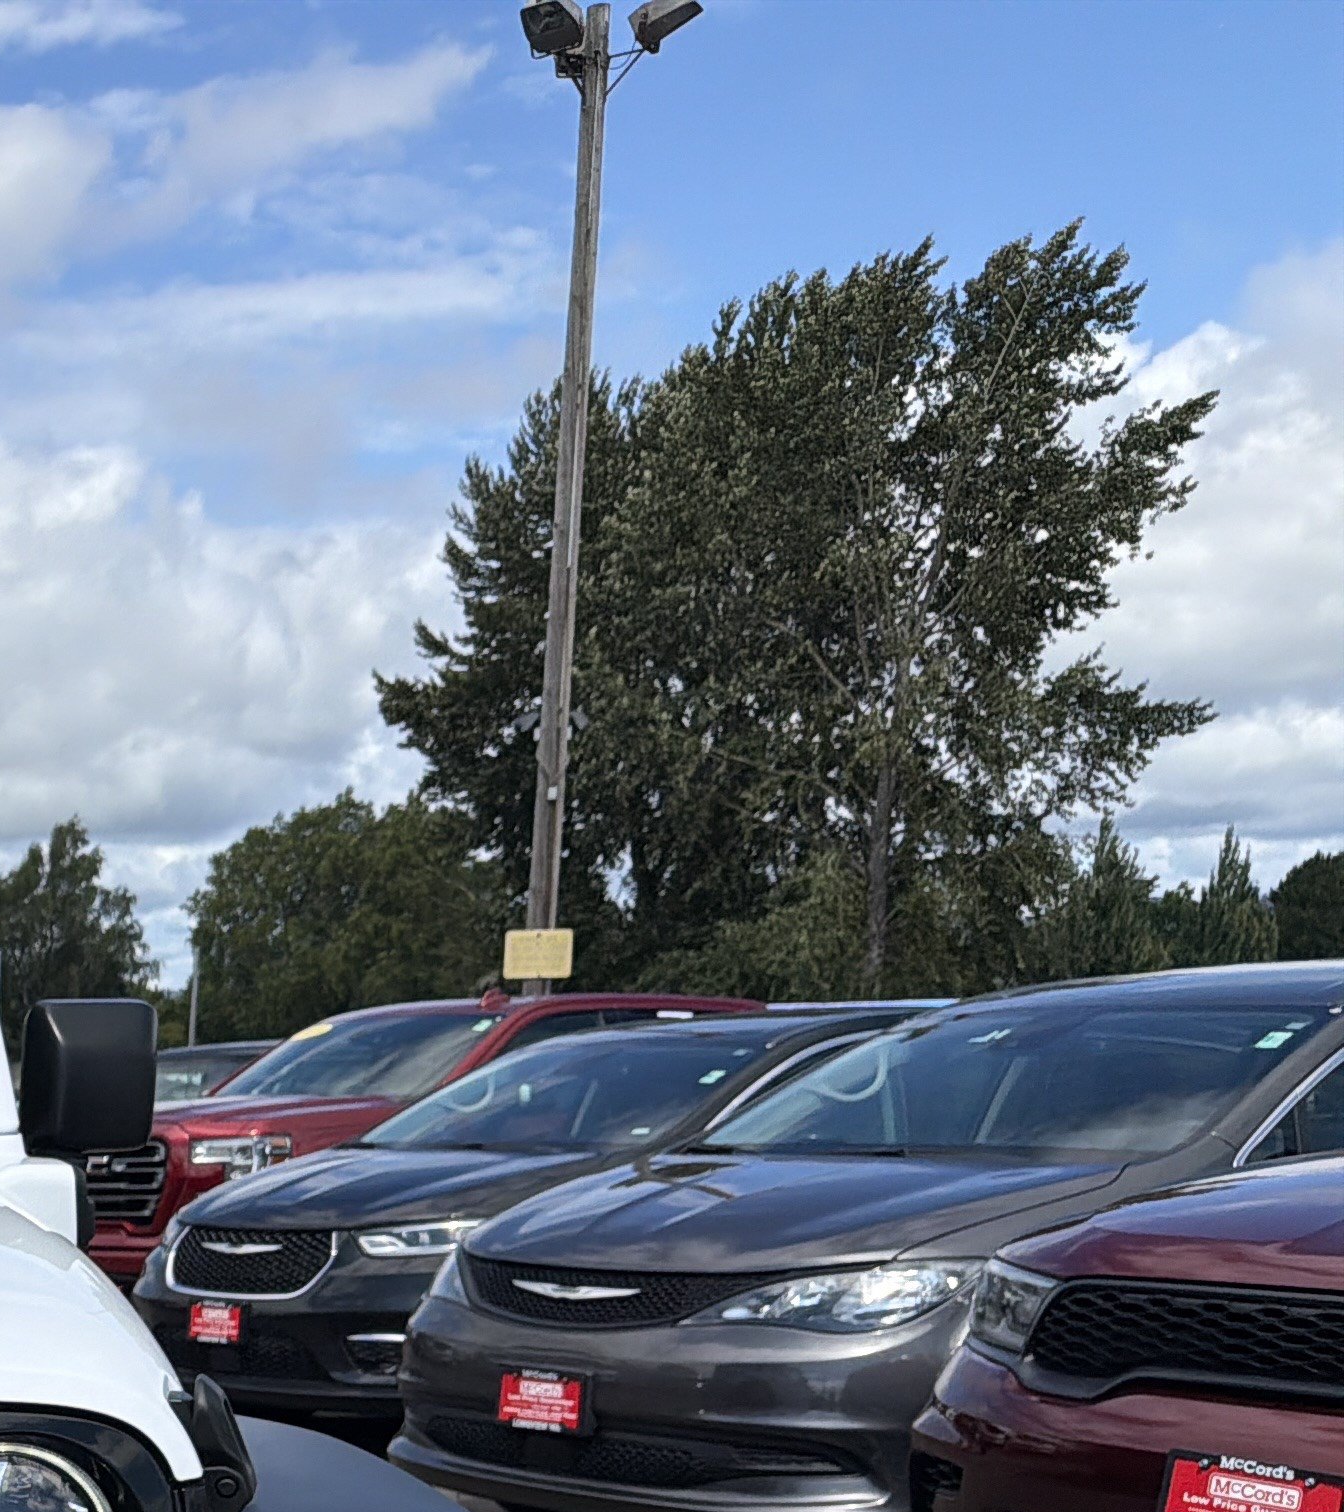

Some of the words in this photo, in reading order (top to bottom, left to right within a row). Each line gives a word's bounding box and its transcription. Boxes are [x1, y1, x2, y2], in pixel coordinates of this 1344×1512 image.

[1219, 1455, 1295, 1481] McCord's
[1213, 1478, 1296, 1507] McCord's
[1213, 1497, 1247, 1512] Price
